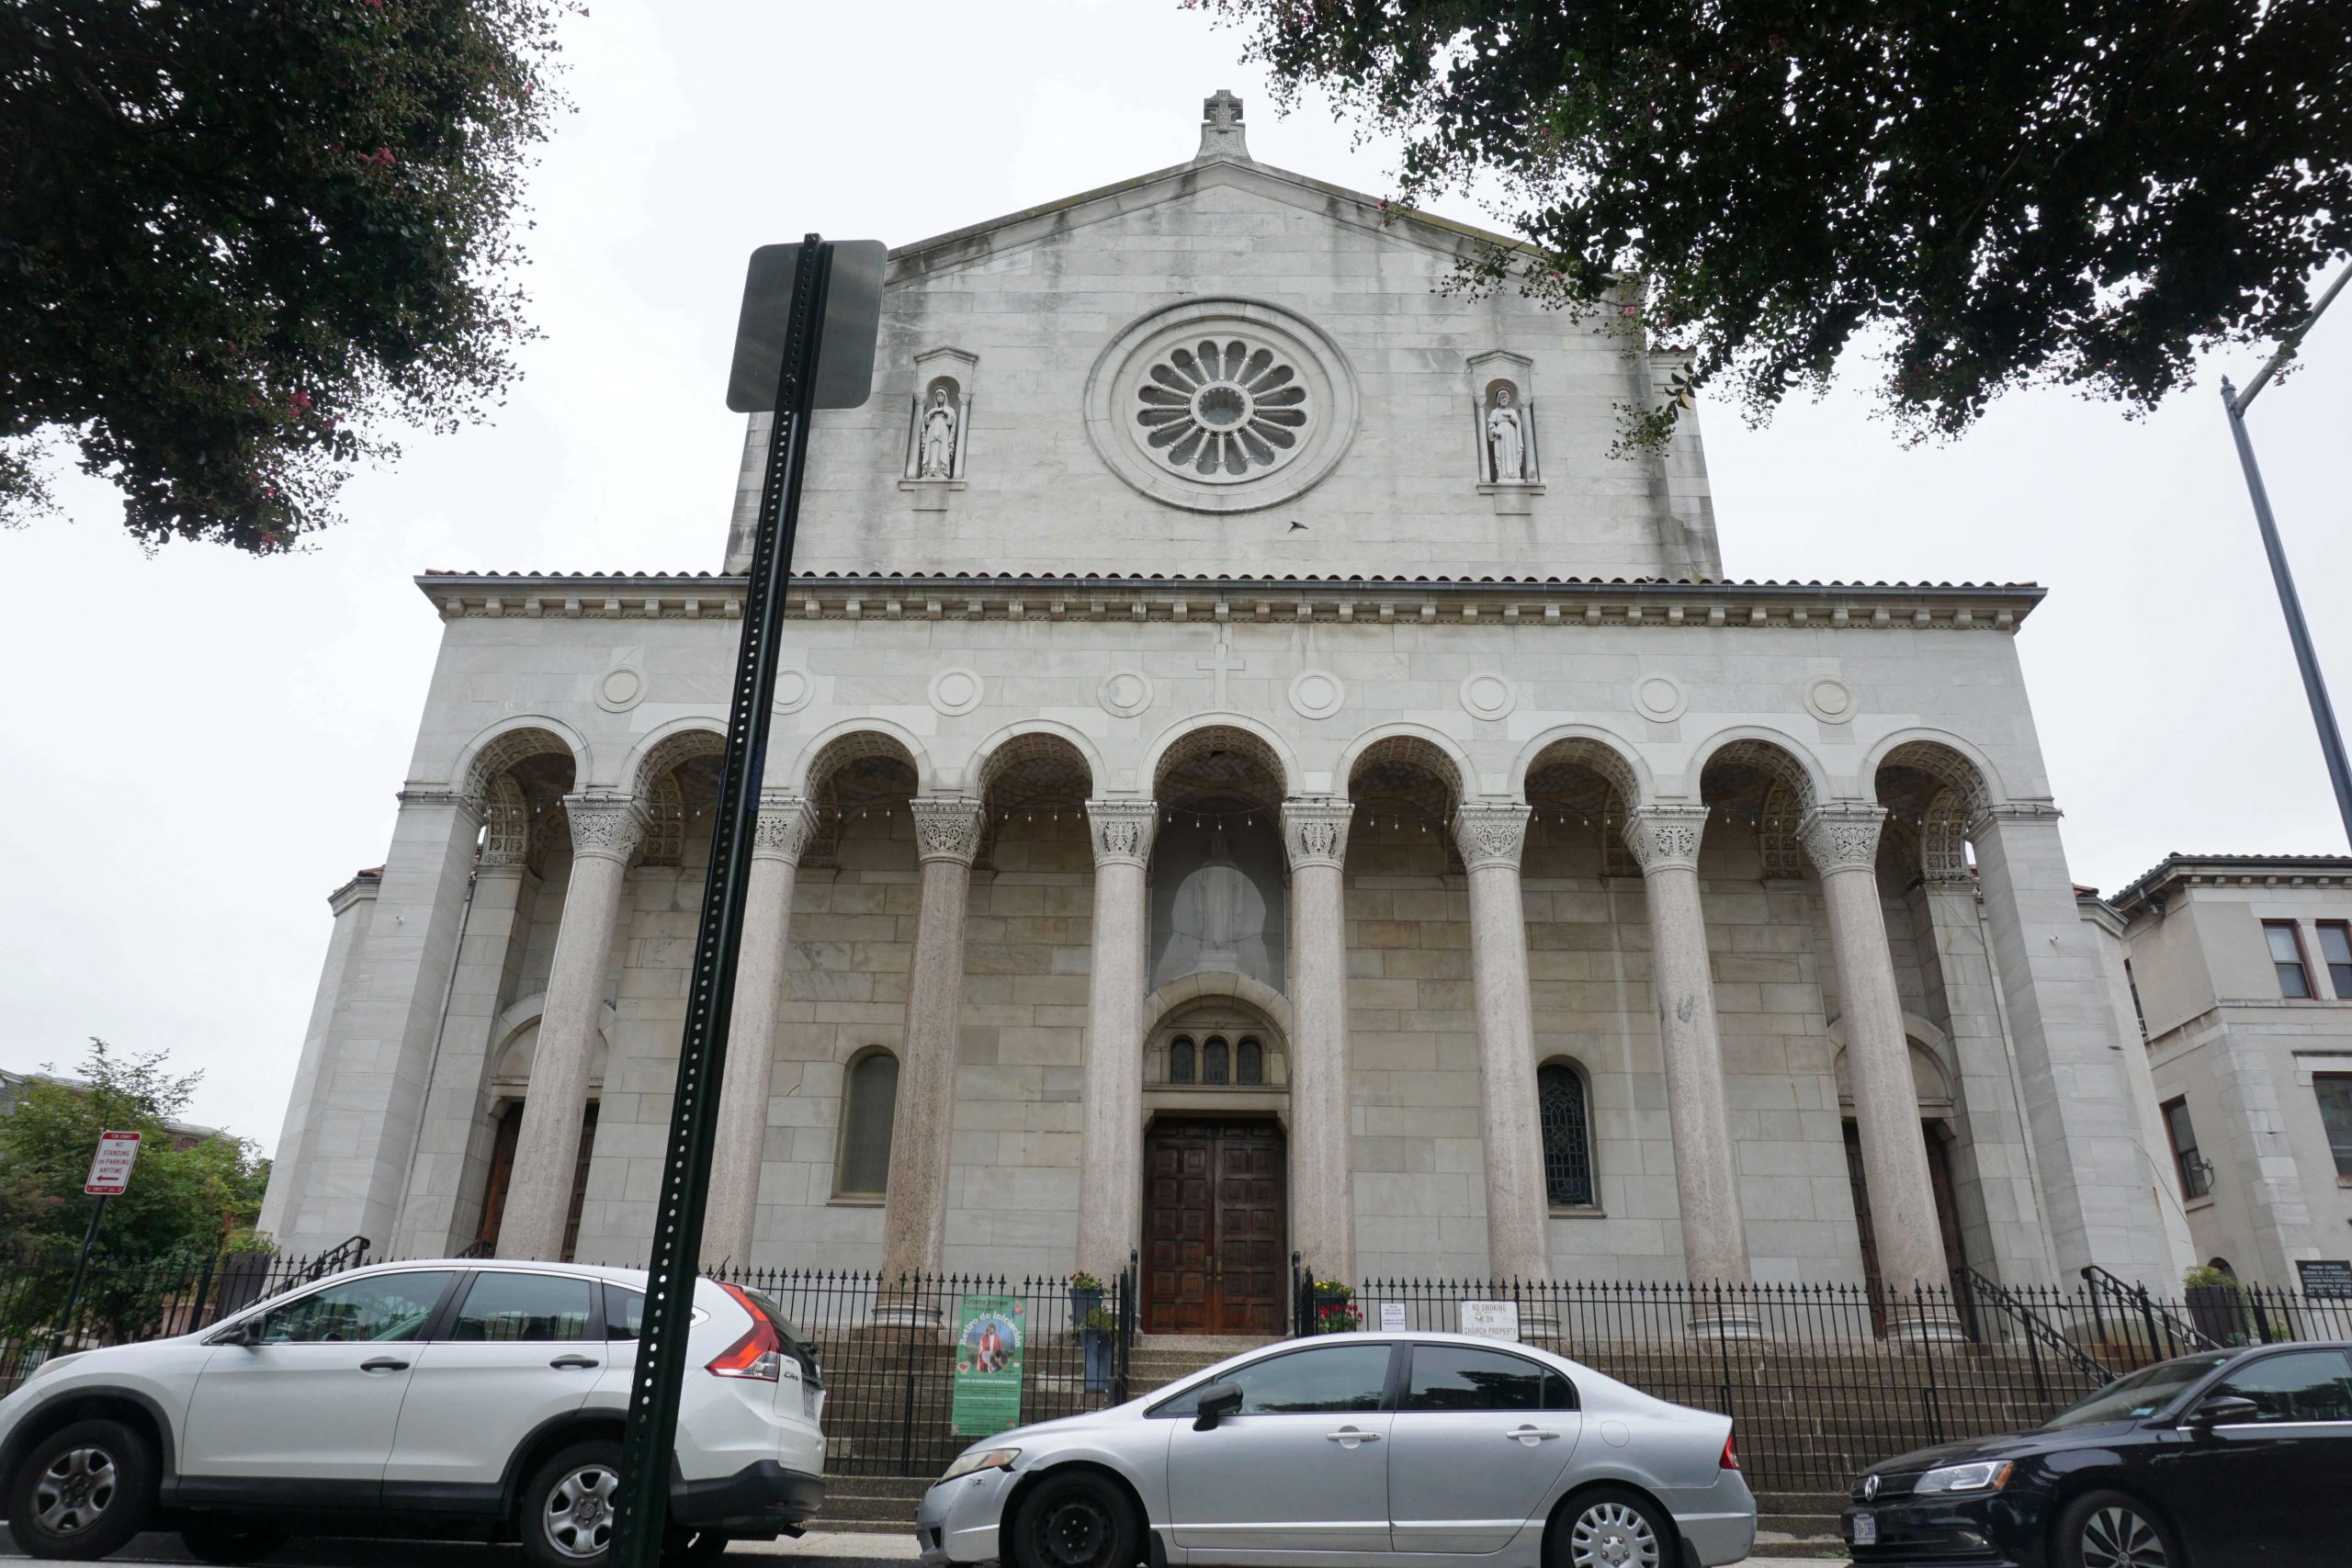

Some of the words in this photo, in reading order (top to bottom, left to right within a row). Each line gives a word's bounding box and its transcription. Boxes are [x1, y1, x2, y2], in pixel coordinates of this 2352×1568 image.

[1482, 1303, 1506, 1312] SMOKING
[959, 1318, 978, 1345] Retiro
[979, 1312, 991, 1320] de
[1464, 1326, 1487, 1335] CHURCH
[1488, 1327, 1516, 1336] PROPERTY
